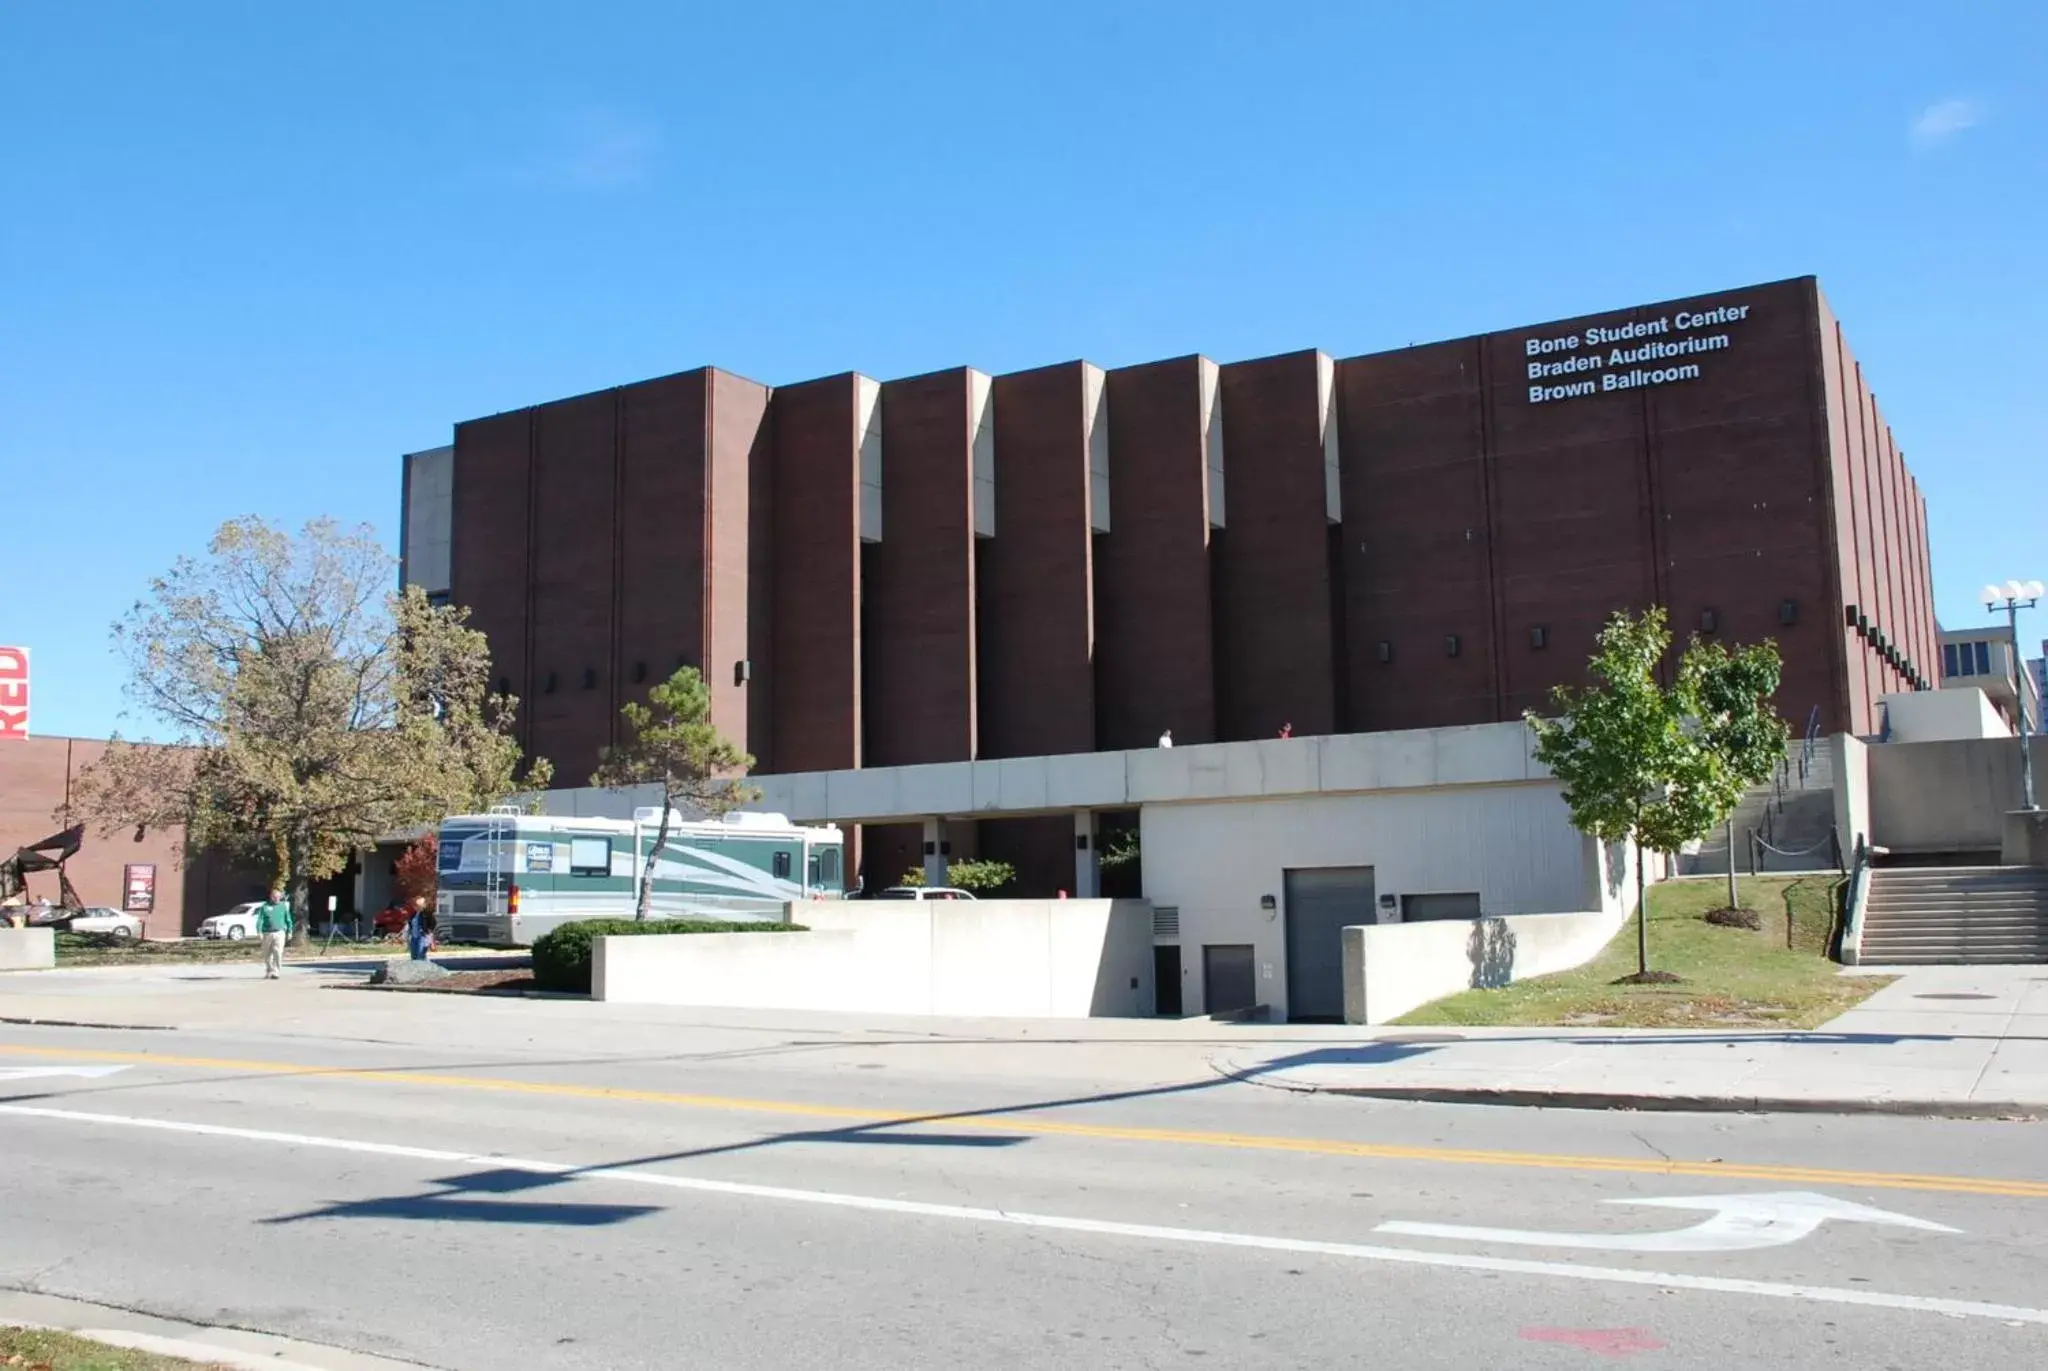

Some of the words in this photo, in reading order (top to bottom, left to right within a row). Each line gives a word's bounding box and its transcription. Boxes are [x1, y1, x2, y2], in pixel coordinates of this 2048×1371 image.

[1526, 335, 1579, 356] Bone
[1586, 317, 1669, 346] Student
[1675, 304, 1750, 330] Center
[1528, 355, 1602, 379] Braden
[1608, 334, 1729, 366] Auditorium
[1529, 381, 1596, 403] Brown
[1602, 364, 1700, 391] Ballroom
[0, 647, 28, 739] RED
